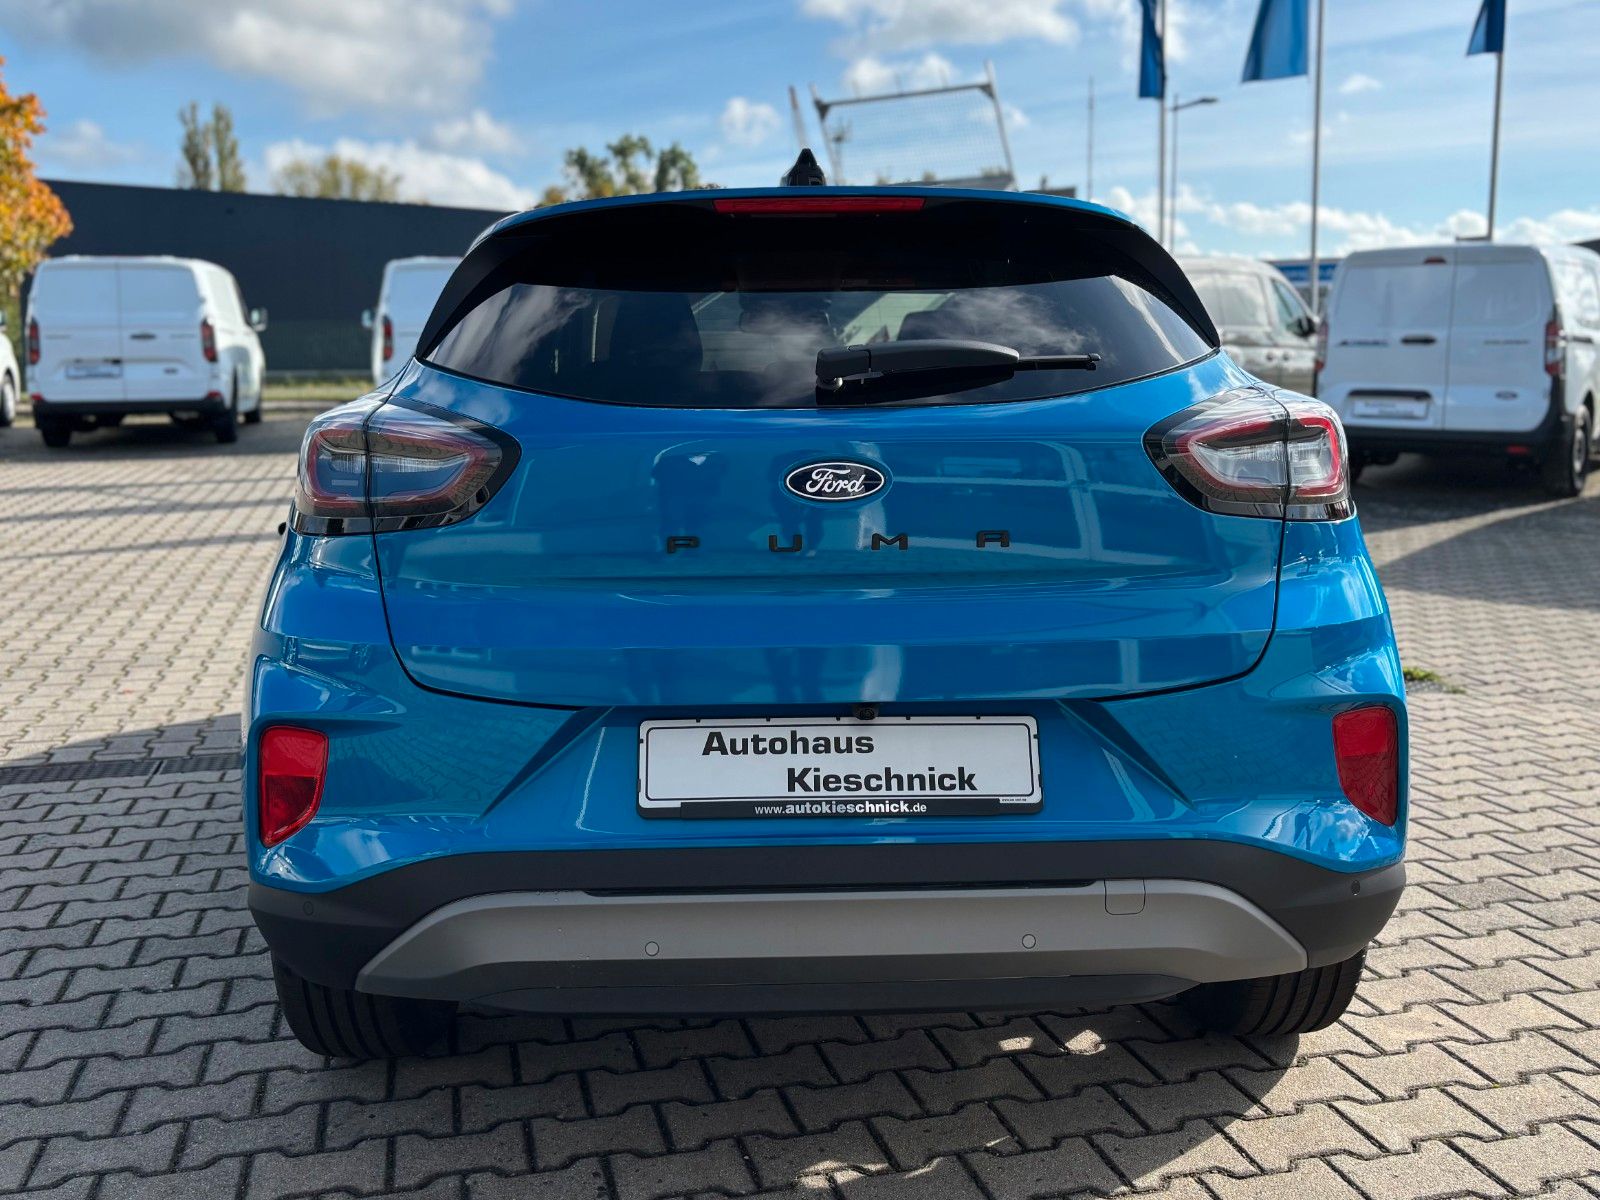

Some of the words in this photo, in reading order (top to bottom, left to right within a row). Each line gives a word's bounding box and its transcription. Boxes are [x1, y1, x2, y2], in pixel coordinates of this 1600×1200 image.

[805, 467, 866, 494] Ford
[667, 530, 1010, 553] PUMA
[702, 730, 875, 756] Autohaus
[787, 766, 978, 793] Kieschnick
[754, 800, 927, 815] www.autokieschnick.de
